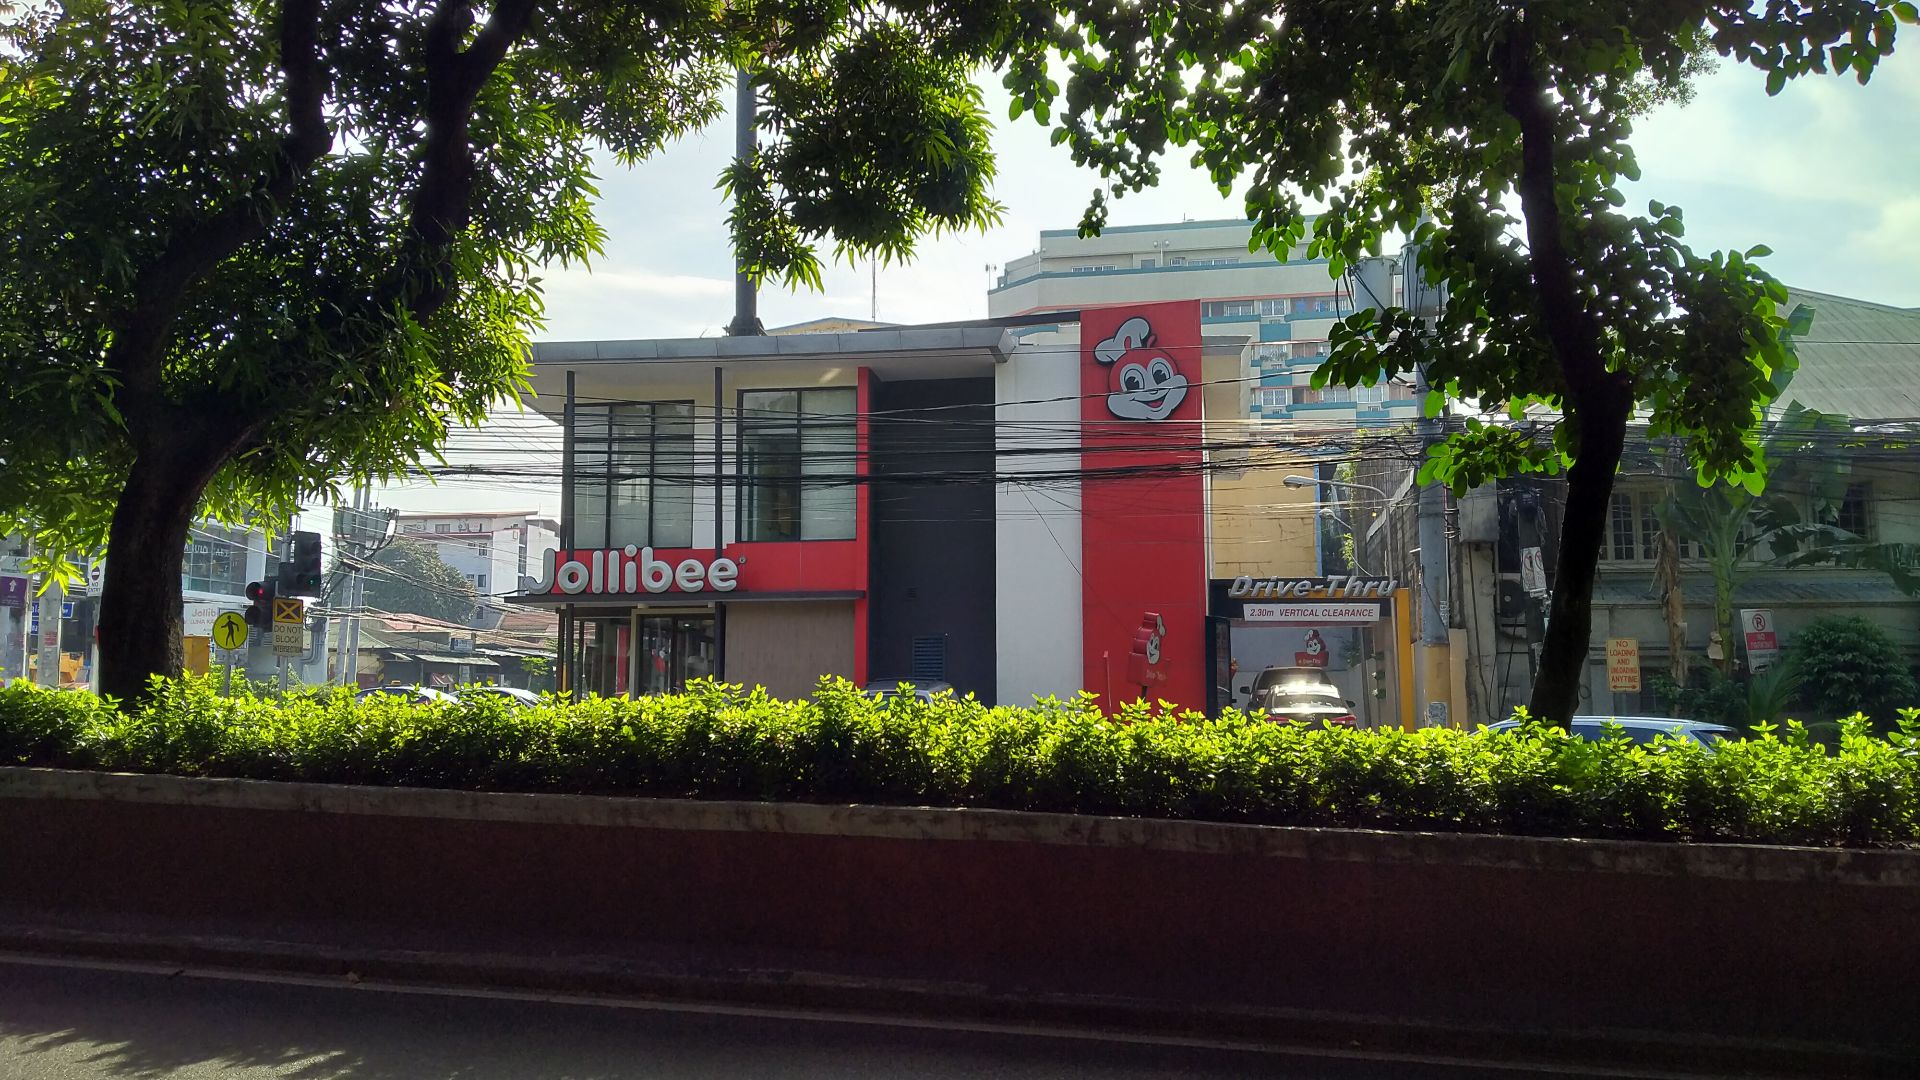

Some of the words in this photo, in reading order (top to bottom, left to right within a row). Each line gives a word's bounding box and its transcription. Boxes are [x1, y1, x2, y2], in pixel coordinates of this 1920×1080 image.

[524, 544, 738, 594] Jollibee
[1228, 575, 1398, 598] Drive-Thru
[1249, 608, 1274, 617] 2.30m
[1279, 608, 1319, 617] VERTICAL
[1321, 608, 1373, 617] CLEARANCE
[287, 626, 302, 634] NOT
[276, 635, 299, 643] BLOCK
[1611, 675, 1638, 683] ANYTIME
